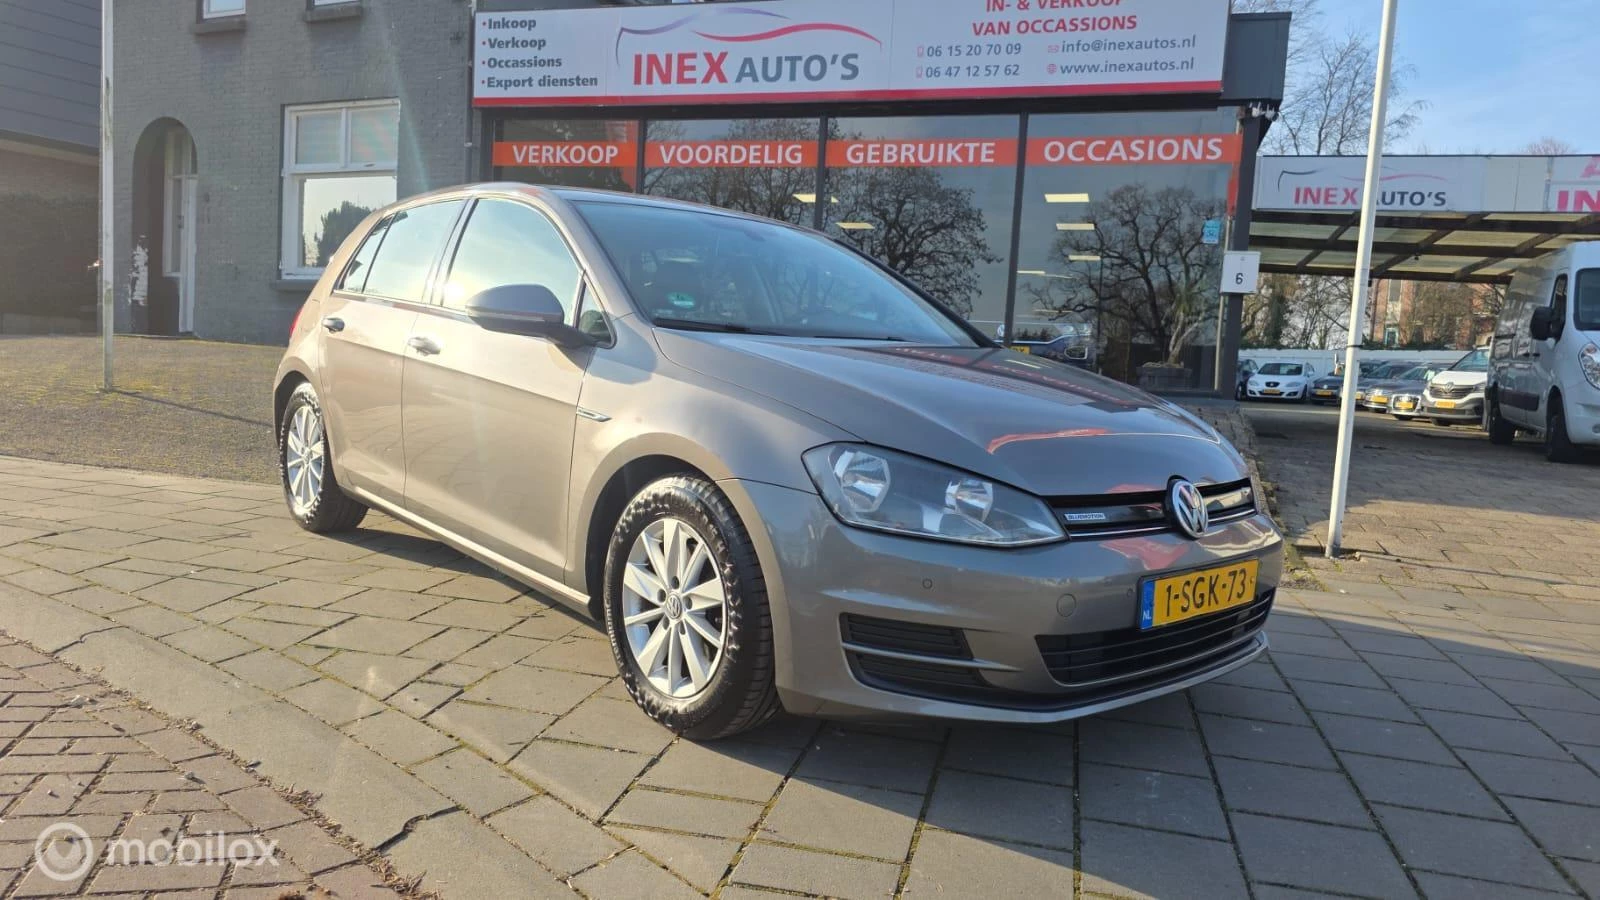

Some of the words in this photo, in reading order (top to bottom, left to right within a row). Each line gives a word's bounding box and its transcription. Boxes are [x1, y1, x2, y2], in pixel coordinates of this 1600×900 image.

[1017, 0, 1030, 10] &
[488, 17, 537, 31] Inkoop
[972, 21, 1010, 36] VAN
[1016, 15, 1137, 34] OCCASSIONS
[487, 37, 546, 50] Verkoop
[927, 46, 942, 57] 06
[948, 45, 961, 56] 15
[966, 44, 981, 56] 20
[986, 44, 1001, 55] 70
[1005, 43, 1021, 55] 09
[1062, 34, 1196, 53] info@inexautos.nl
[487, 56, 562, 68] Occassions
[633, 51, 728, 85] INEX
[735, 53, 859, 83] AUTO'S
[1060, 56, 1194, 74] www.inexautos.nl
[925, 66, 941, 78] 06
[945, 66, 960, 77] 47
[966, 66, 980, 77] 12
[984, 65, 1000, 76] 57
[1004, 64, 1019, 75] 62
[486, 76, 533, 90] Export
[537, 75, 598, 87] diensten
[512, 145, 618, 164] VERKOOP
[660, 144, 802, 164] VOORDELIG
[846, 142, 996, 164] GEBRUIKTE
[1044, 138, 1223, 162] OCCASIONS
[1294, 186, 1359, 205] INEX
[1375, 191, 1446, 206] UTO'S
[1235, 272, 1243, 285] 6
[1166, 568, 1246, 617] 1-SGK-73
[1143, 610, 1152, 620] NL
